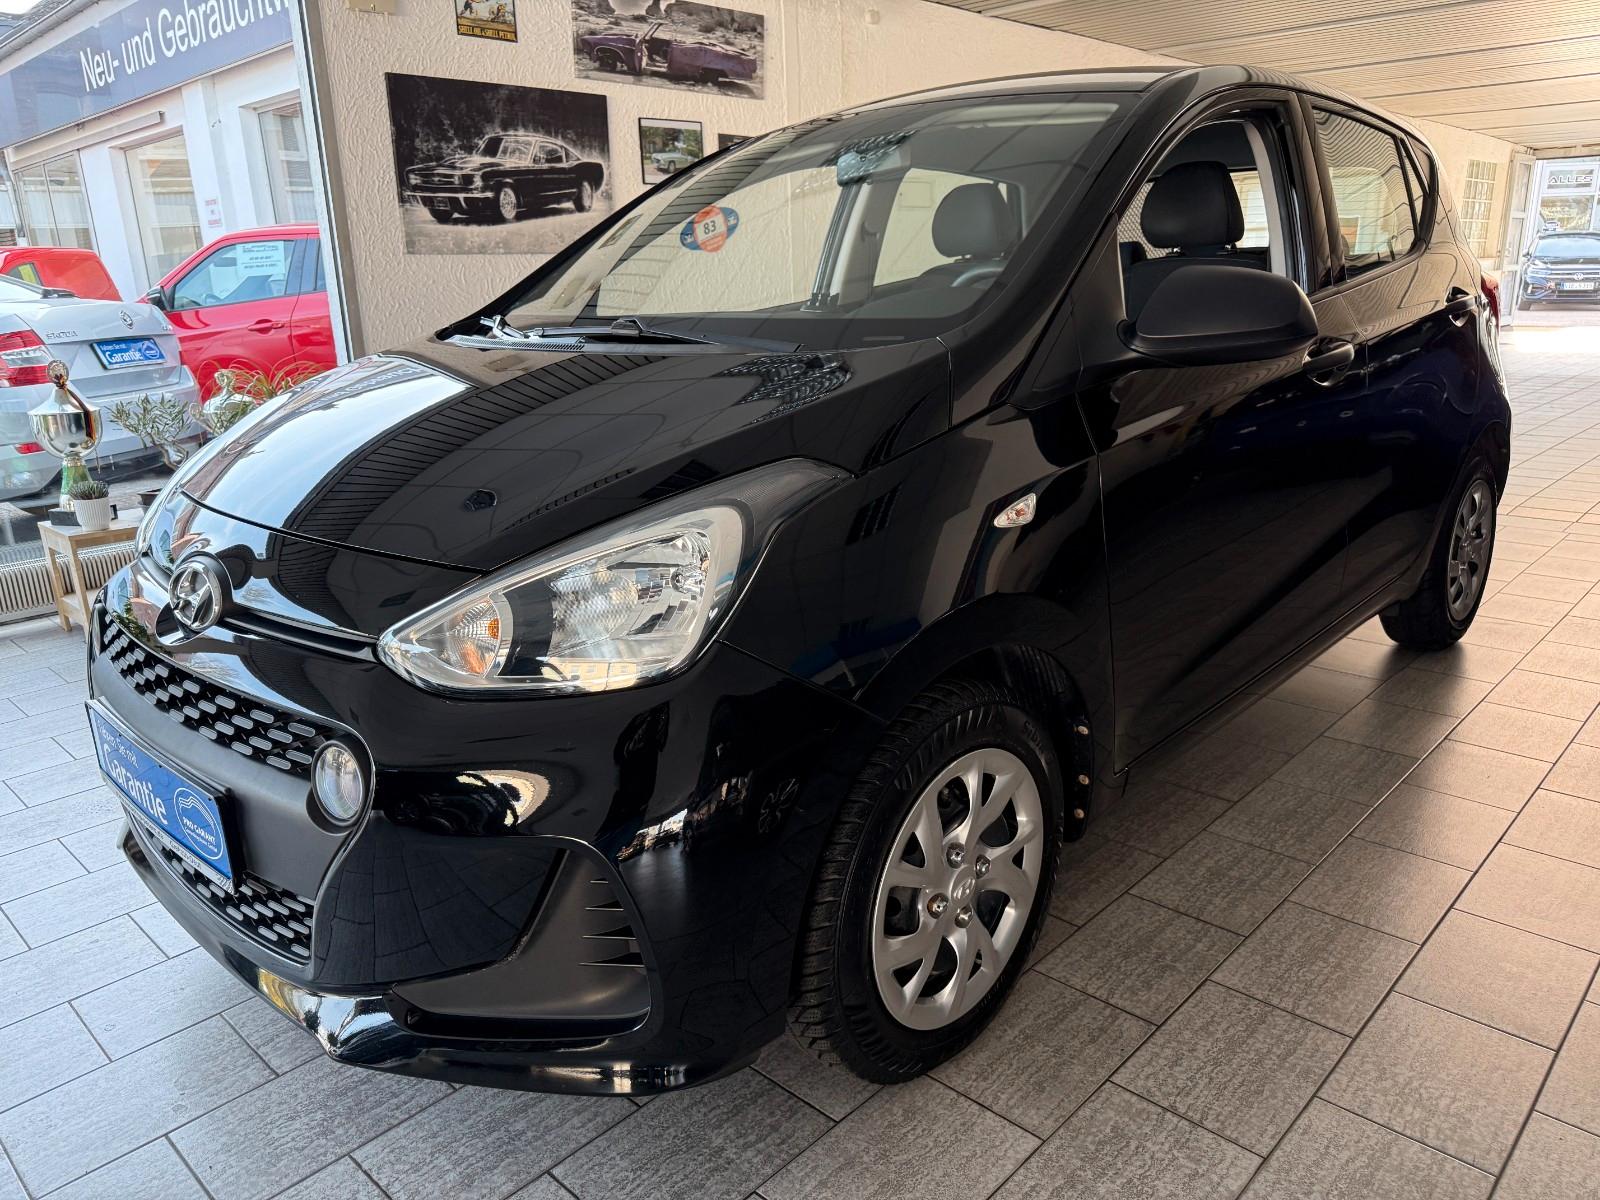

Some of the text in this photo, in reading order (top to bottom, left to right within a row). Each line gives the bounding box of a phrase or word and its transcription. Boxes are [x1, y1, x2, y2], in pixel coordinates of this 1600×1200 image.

[80, 0, 289, 92] Neu- und Gebrauc
[703, 220, 716, 235] 83
[105, 348, 144, 363] Garantie
[103, 743, 168, 825] Garantie
